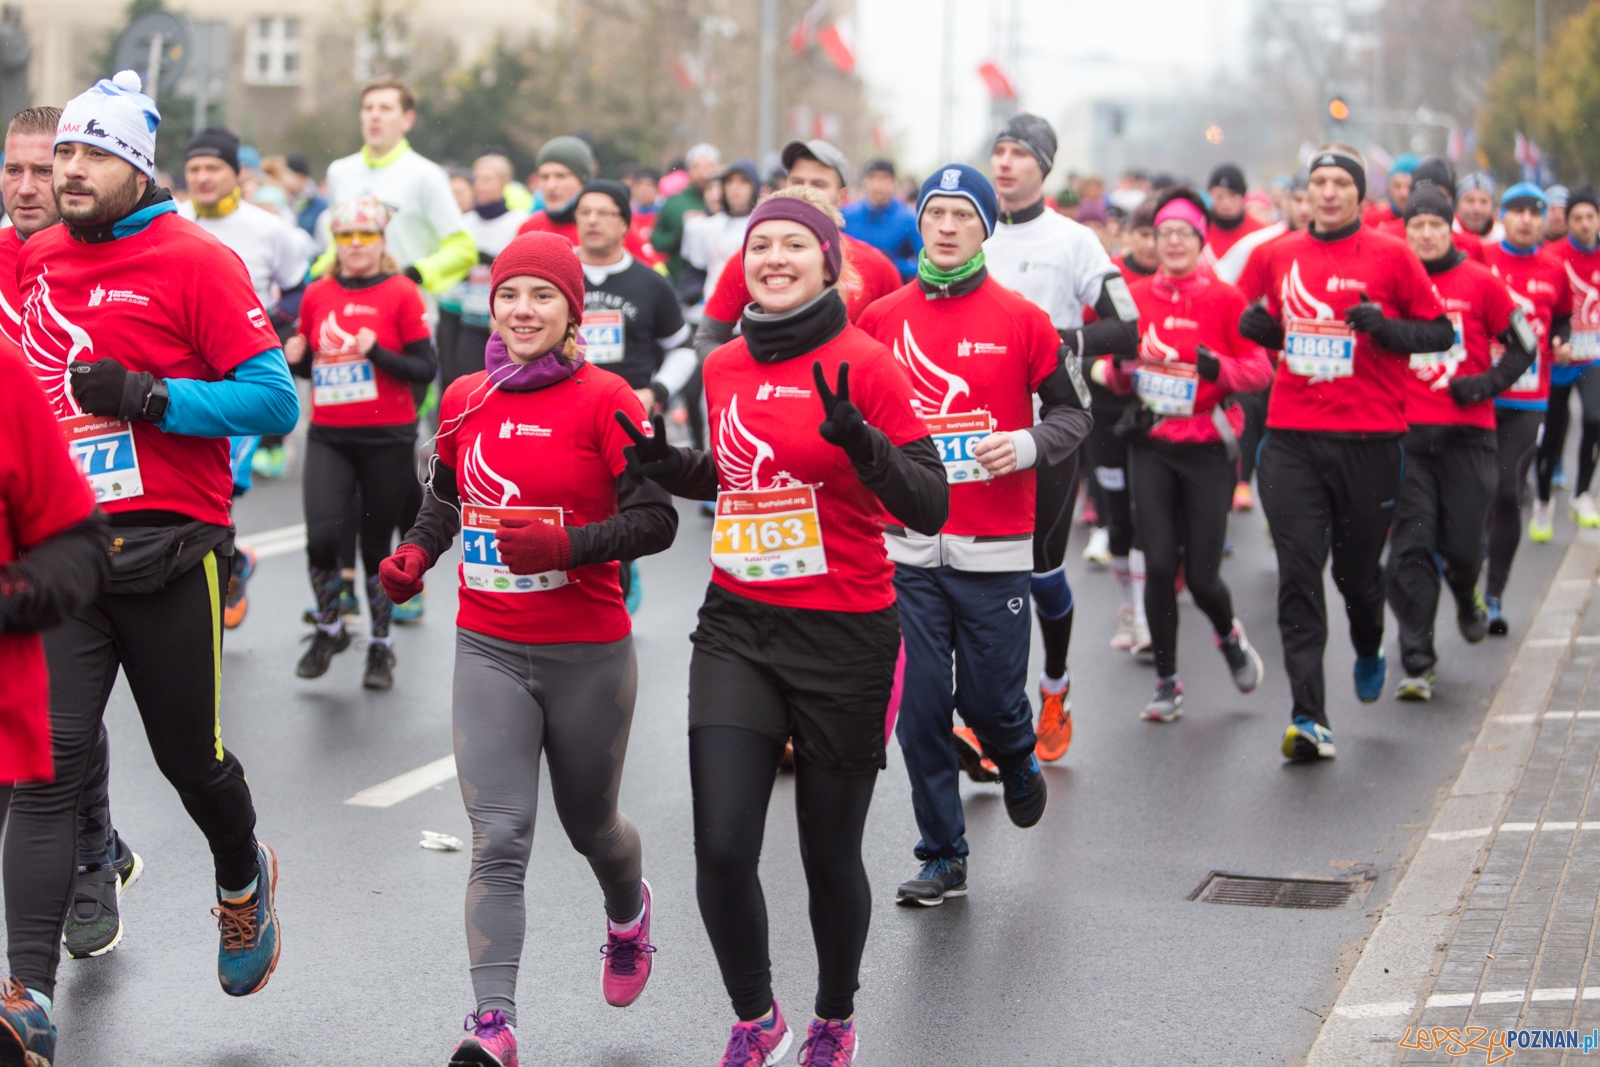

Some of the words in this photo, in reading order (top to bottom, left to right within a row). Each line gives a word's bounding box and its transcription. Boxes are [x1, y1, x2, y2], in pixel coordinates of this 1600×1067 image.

[580, 328, 615, 345] 44
[73, 421, 121, 434] RunPoland.org
[946, 421, 985, 429] RunPoland.org
[71, 440, 119, 474] 77
[757, 497, 807, 508] RunPoland.org
[726, 517, 807, 551] 1163
[464, 541, 472, 552] E
